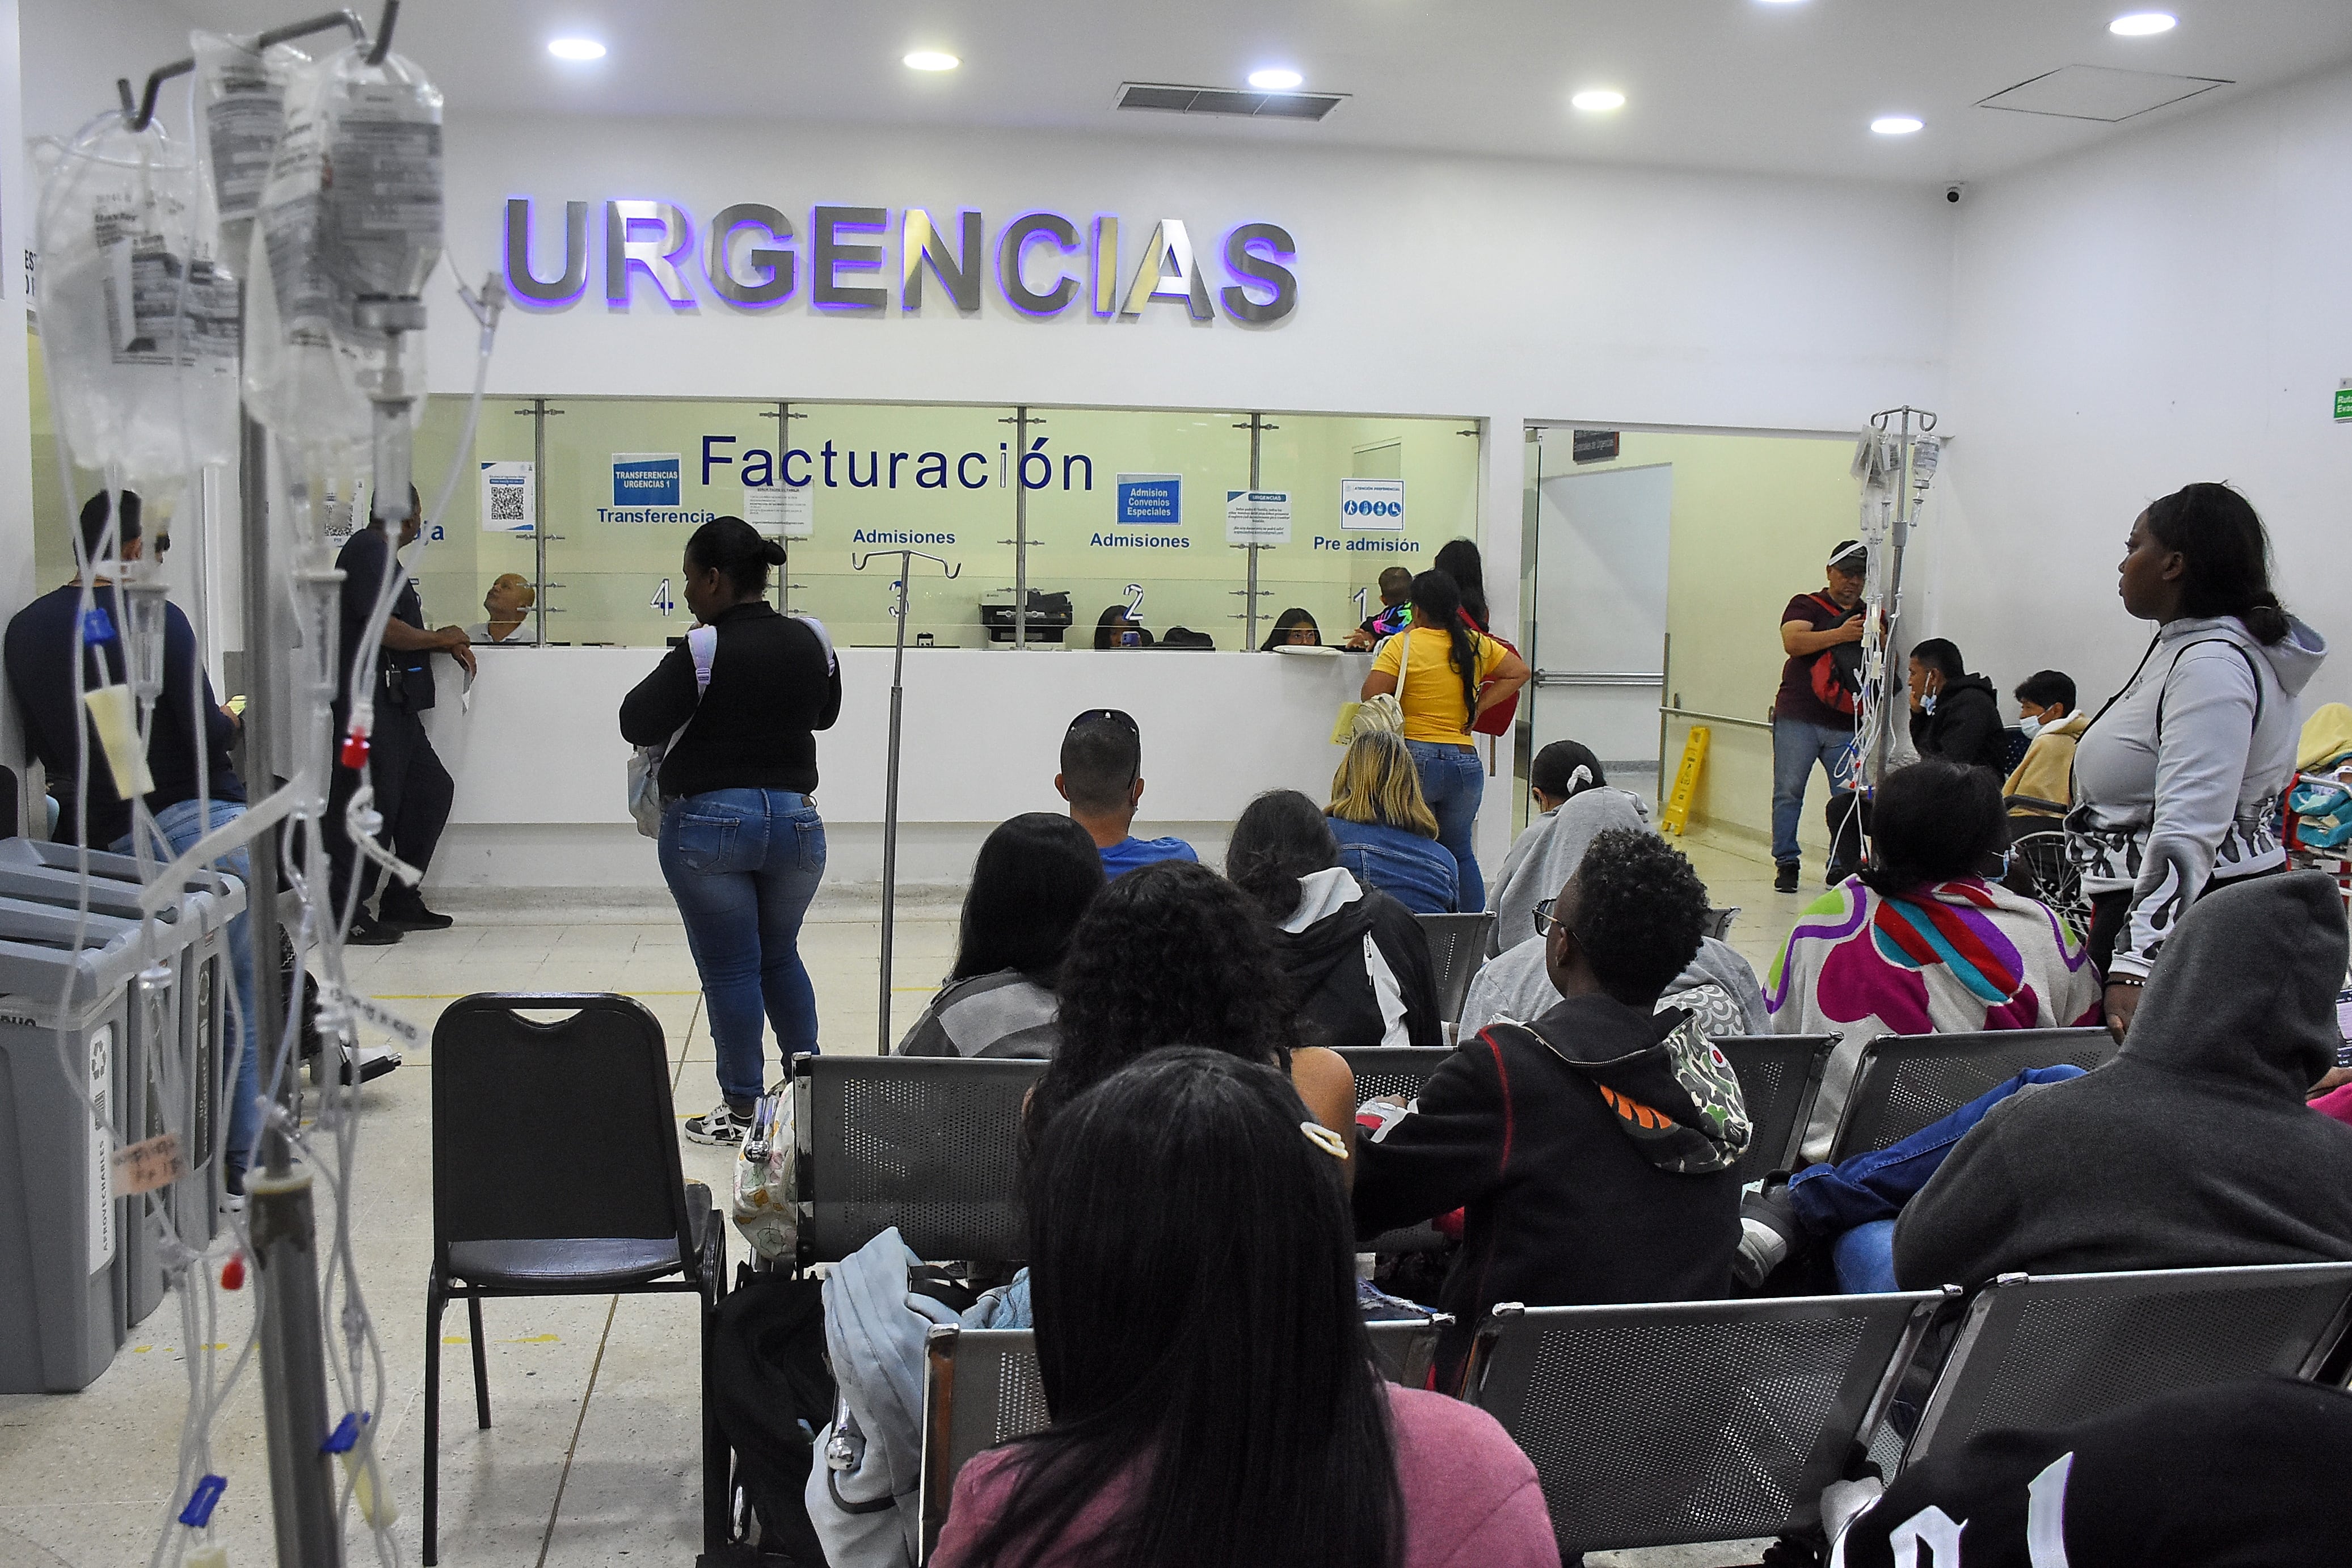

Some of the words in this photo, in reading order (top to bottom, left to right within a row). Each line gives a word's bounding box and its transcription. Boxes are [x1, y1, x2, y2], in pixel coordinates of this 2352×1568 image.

[503, 197, 1300, 324] URGENCIAS
[703, 436, 1094, 491] Facturación
[616, 471, 678, 480] TRANSFERENCIAS
[624, 480, 665, 488] URGENCIAS
[1130, 488, 1168, 497] Admision
[1128, 497, 1170, 506] Convenios
[597, 508, 715, 524] Transferencia
[1127, 507, 1171, 517] Especiales
[853, 528, 956, 545] Admisiones
[1090, 532, 1190, 549] Admisiones
[1314, 536, 1341, 551] Pre
[1345, 535, 1419, 553] admisión
[650, 578, 674, 617] 4
[888, 580, 910, 618] 3
[1123, 583, 1144, 621] 2
[1353, 587, 1367, 622] 1
